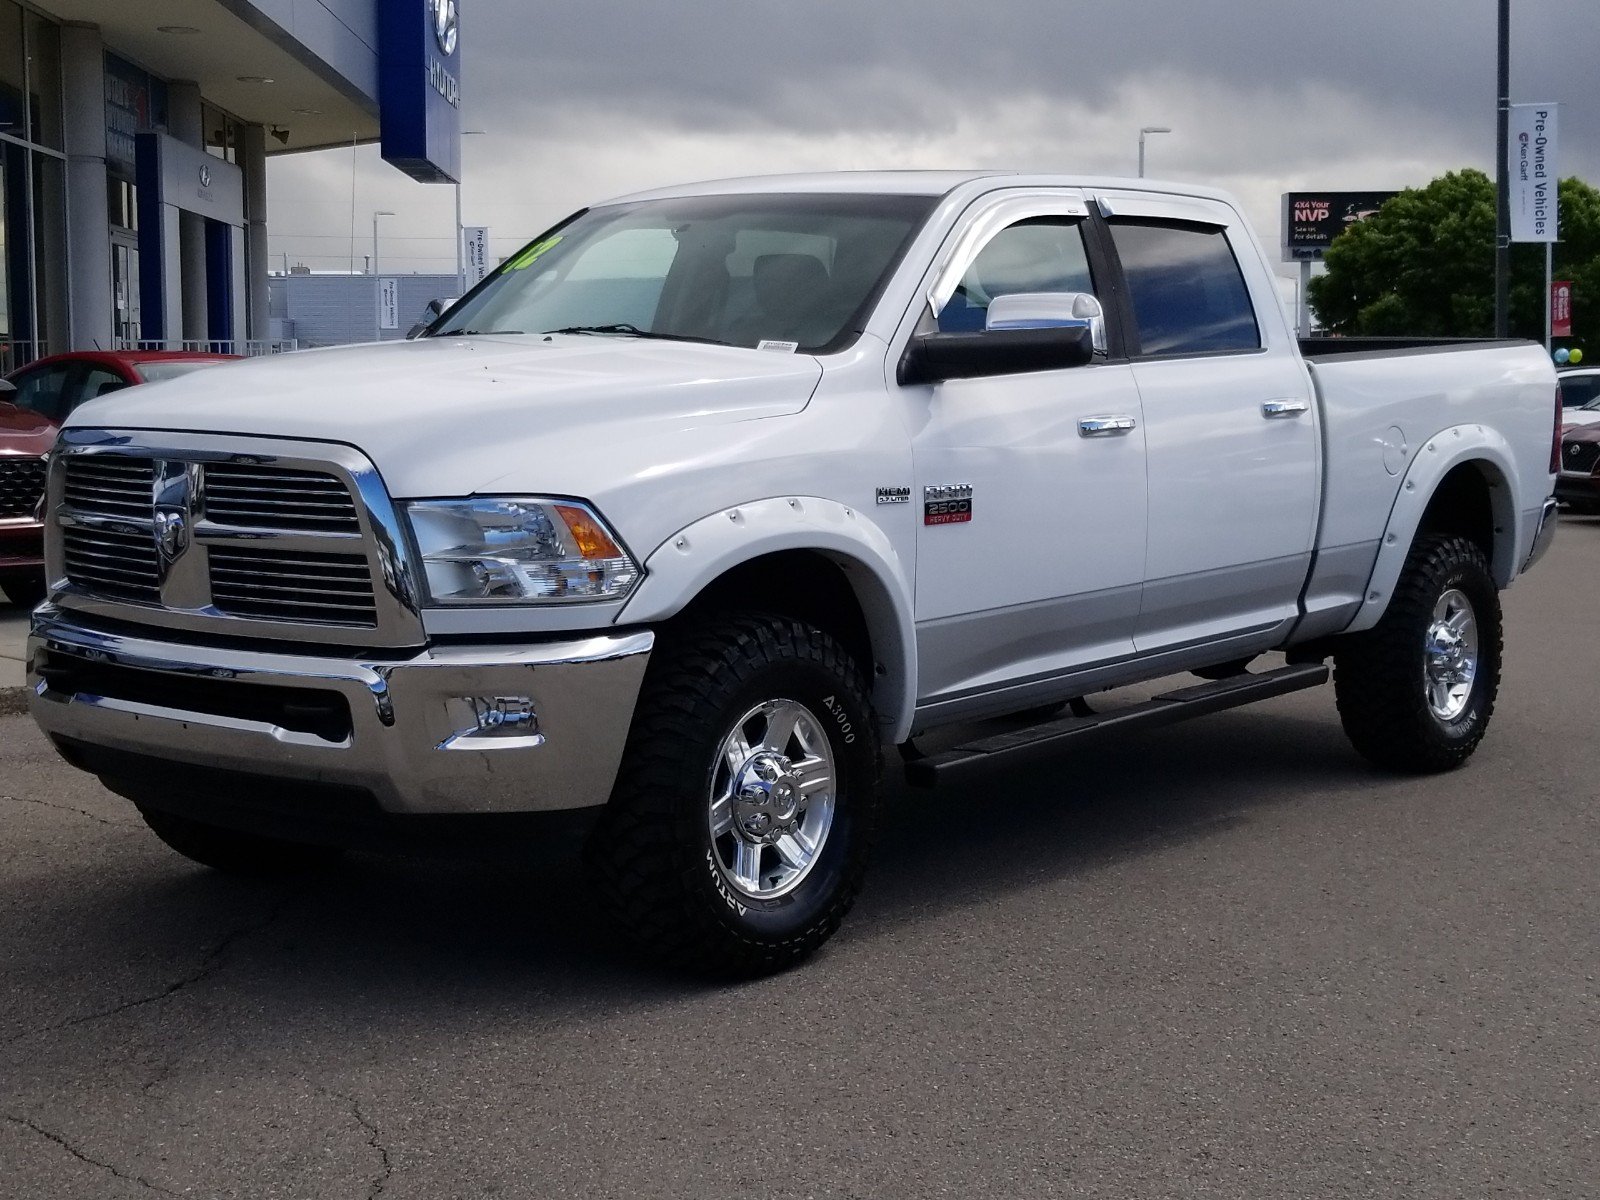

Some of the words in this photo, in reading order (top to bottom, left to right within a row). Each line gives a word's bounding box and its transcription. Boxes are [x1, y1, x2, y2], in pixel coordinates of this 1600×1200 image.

[1535, 111, 1547, 178] Pre-Owned
[1535, 182, 1547, 235] Vehicles
[1294, 209, 1329, 221] NVP
[879, 487, 910, 496] HEMI
[928, 502, 968, 514] 2500
[929, 515, 950, 523] HEAVY
[951, 513, 968, 522] DUTY
[823, 695, 855, 743] A3000
